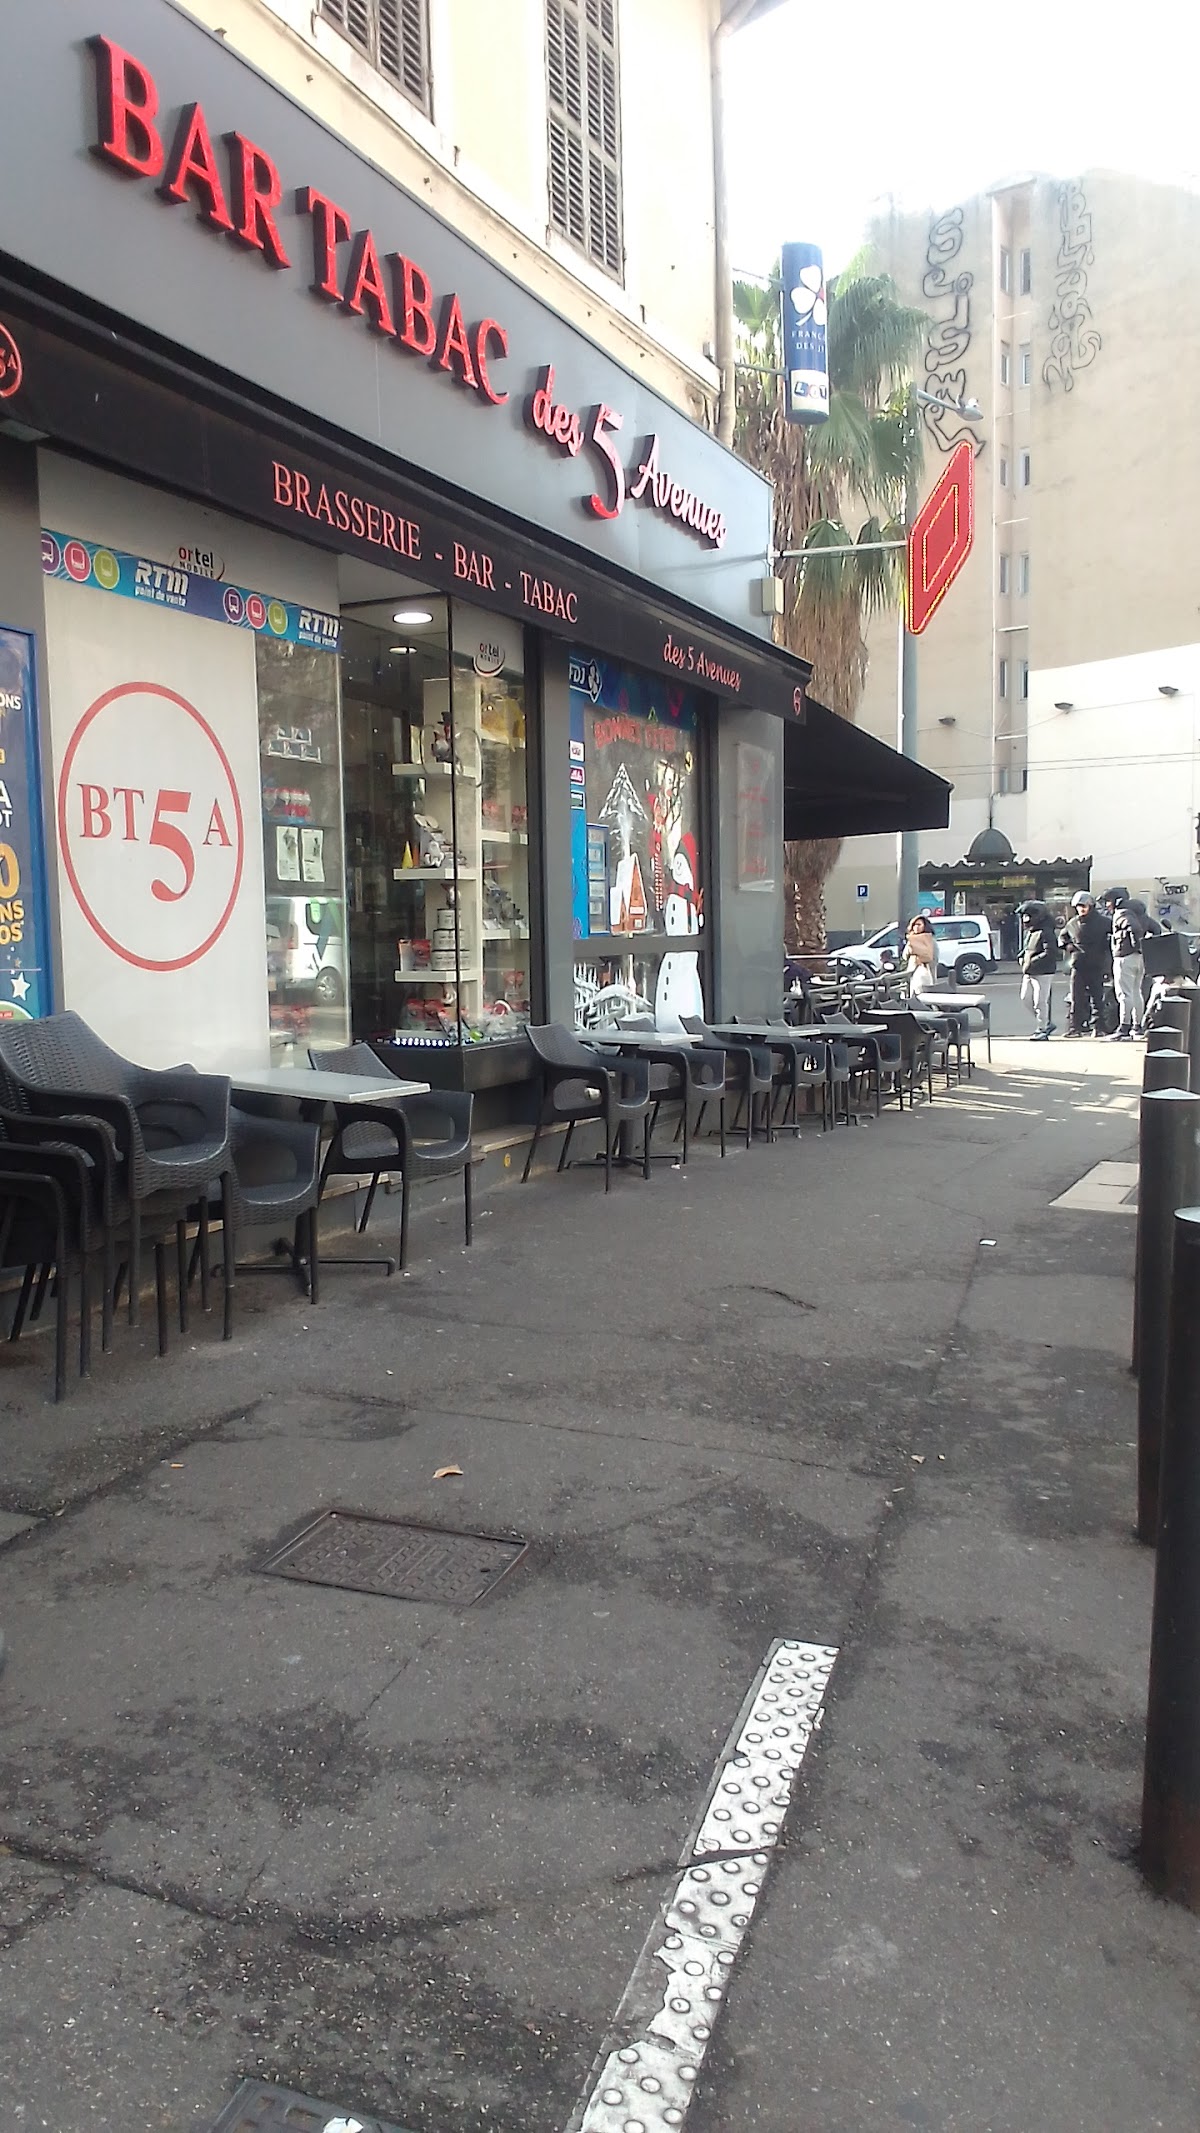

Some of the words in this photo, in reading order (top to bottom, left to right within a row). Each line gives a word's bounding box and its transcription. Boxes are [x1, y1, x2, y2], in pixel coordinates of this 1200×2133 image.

[94, 34, 291, 270] BAR
[297, 186, 509, 405] TABAC
[530, 364, 585, 458] des
[584, 403, 626, 522] 5
[630, 433, 728, 550] Avenues
[796, 342, 815, 350] DES
[272, 460, 422, 560] BRASSERIE
[453, 541, 496, 592] BAR
[520, 570, 578, 624] TABAC
[179, 547, 214, 569] ortel
[180, 561, 214, 578] MOBILE
[135, 586, 155, 599] point
[156, 590, 165, 601] de
[480, 642, 499, 657] ortel
[664, 634, 685, 669] des
[687, 645, 695, 671] 5
[696, 651, 742, 692] Avenues
